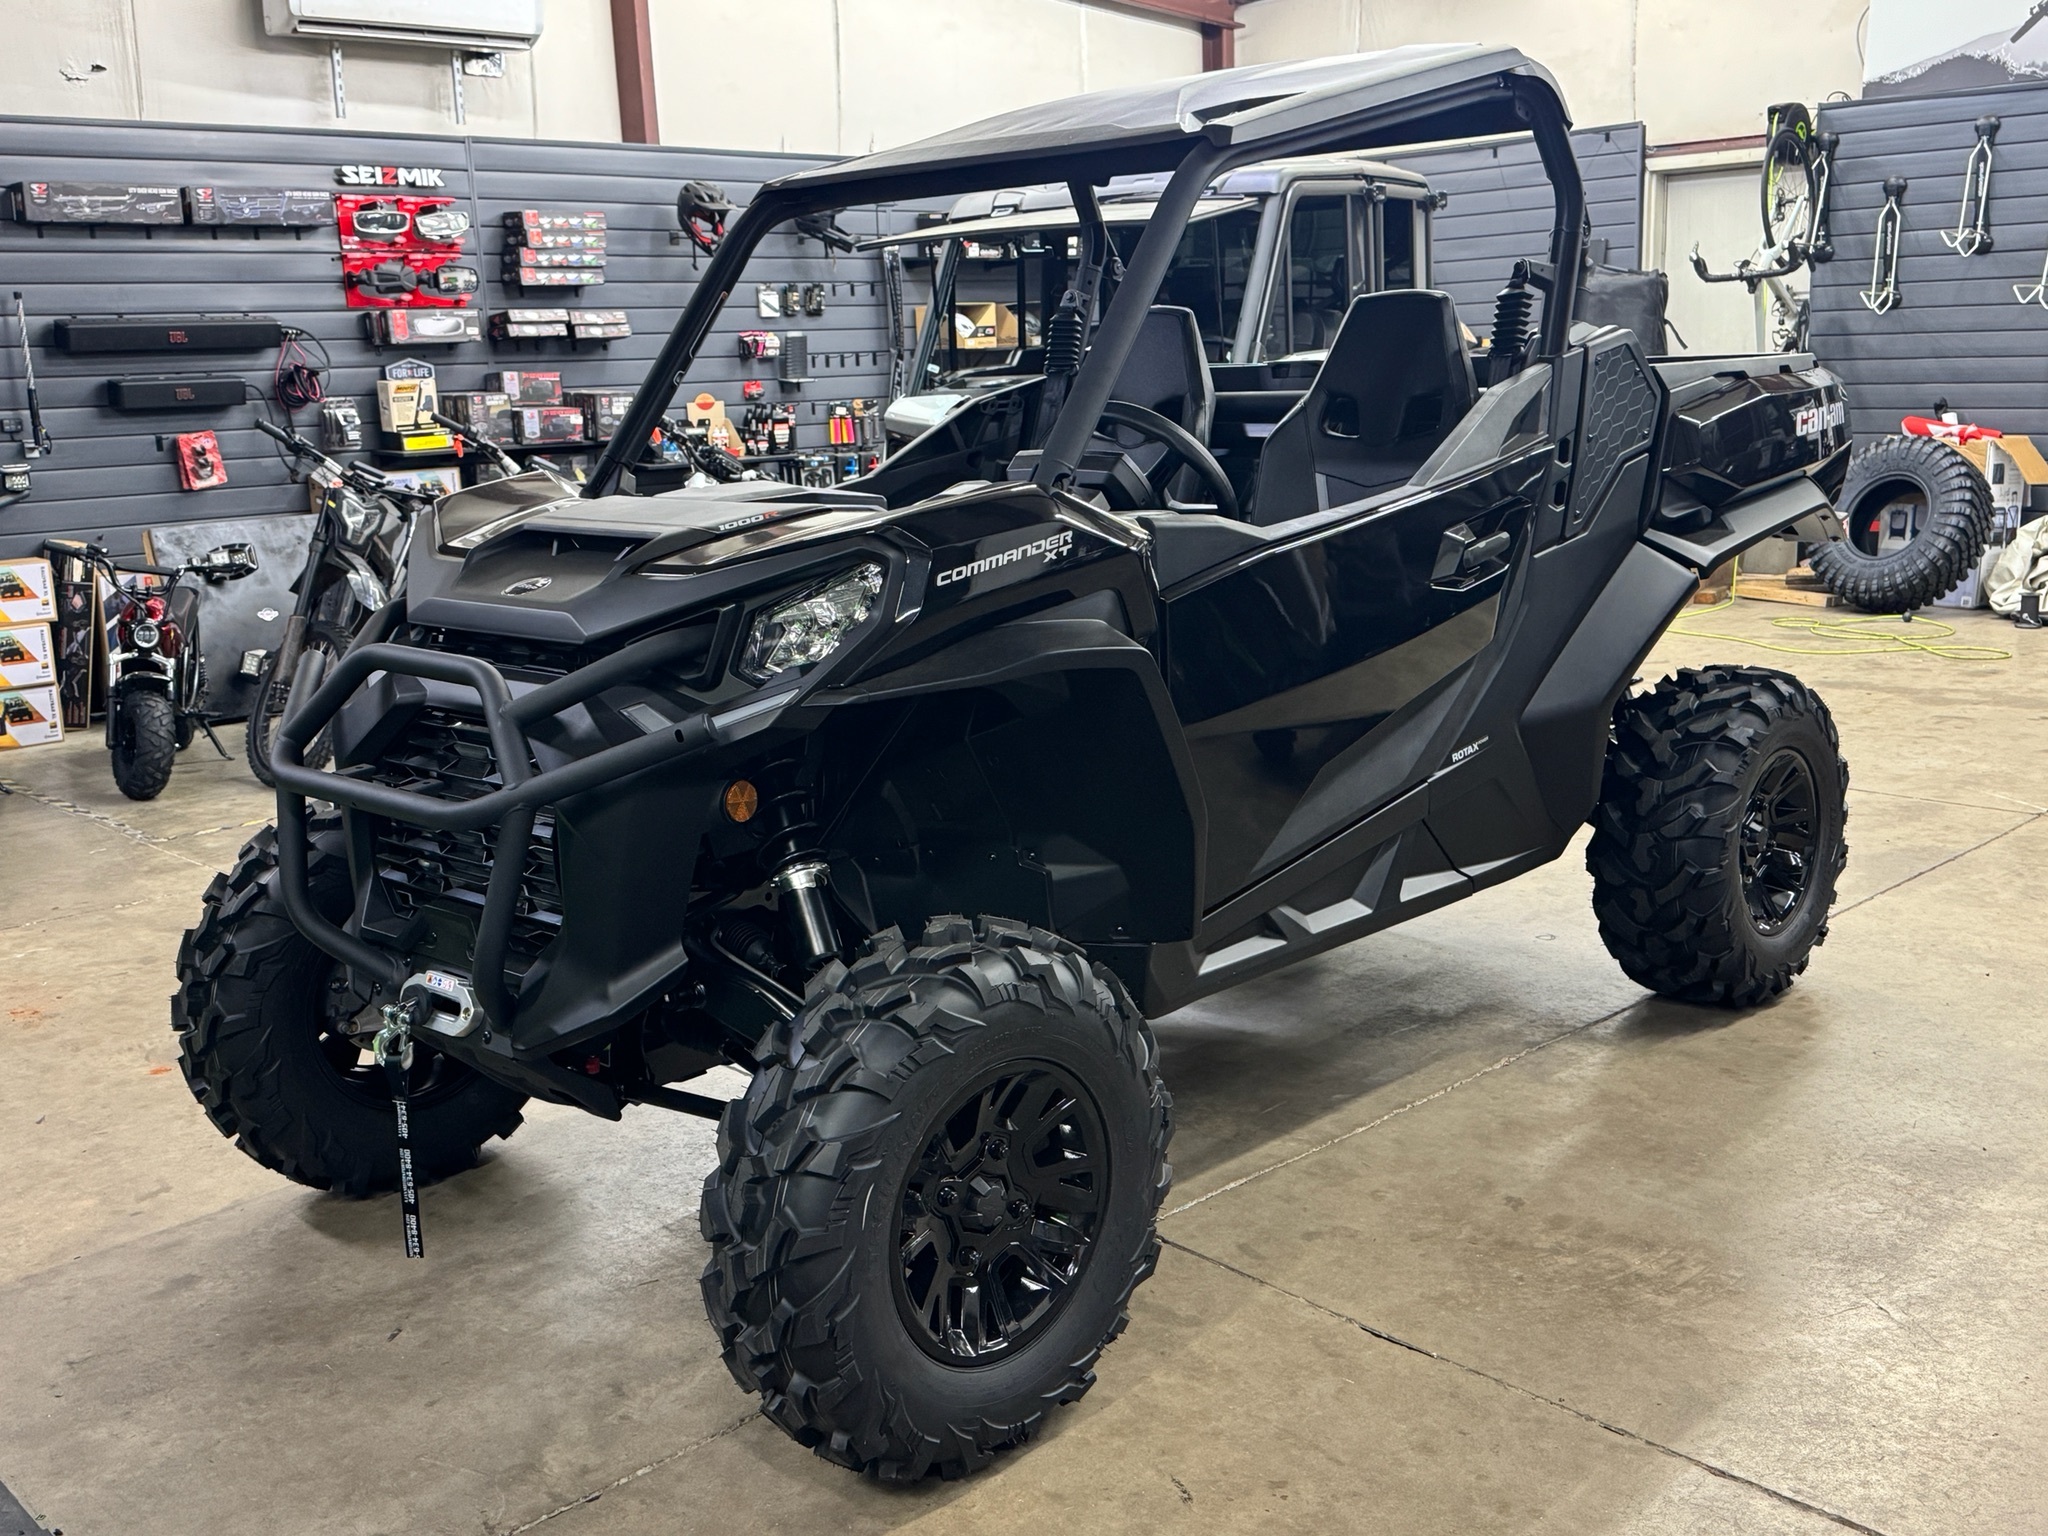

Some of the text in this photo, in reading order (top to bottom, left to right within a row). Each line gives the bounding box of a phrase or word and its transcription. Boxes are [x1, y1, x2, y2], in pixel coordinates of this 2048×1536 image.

[341, 165, 445, 187] SEIZMIK
[169, 331, 189, 343] JBL
[392, 368, 430, 378] FOR LIFE
[175, 388, 195, 400] JBL
[718, 510, 779, 531] 1000R
[936, 530, 1073, 587] COMMANDER
[1043, 544, 1073, 564] XT
[1451, 742, 1480, 763] ROTAX
[404, 1149, 414, 1204] 405-634-8400
